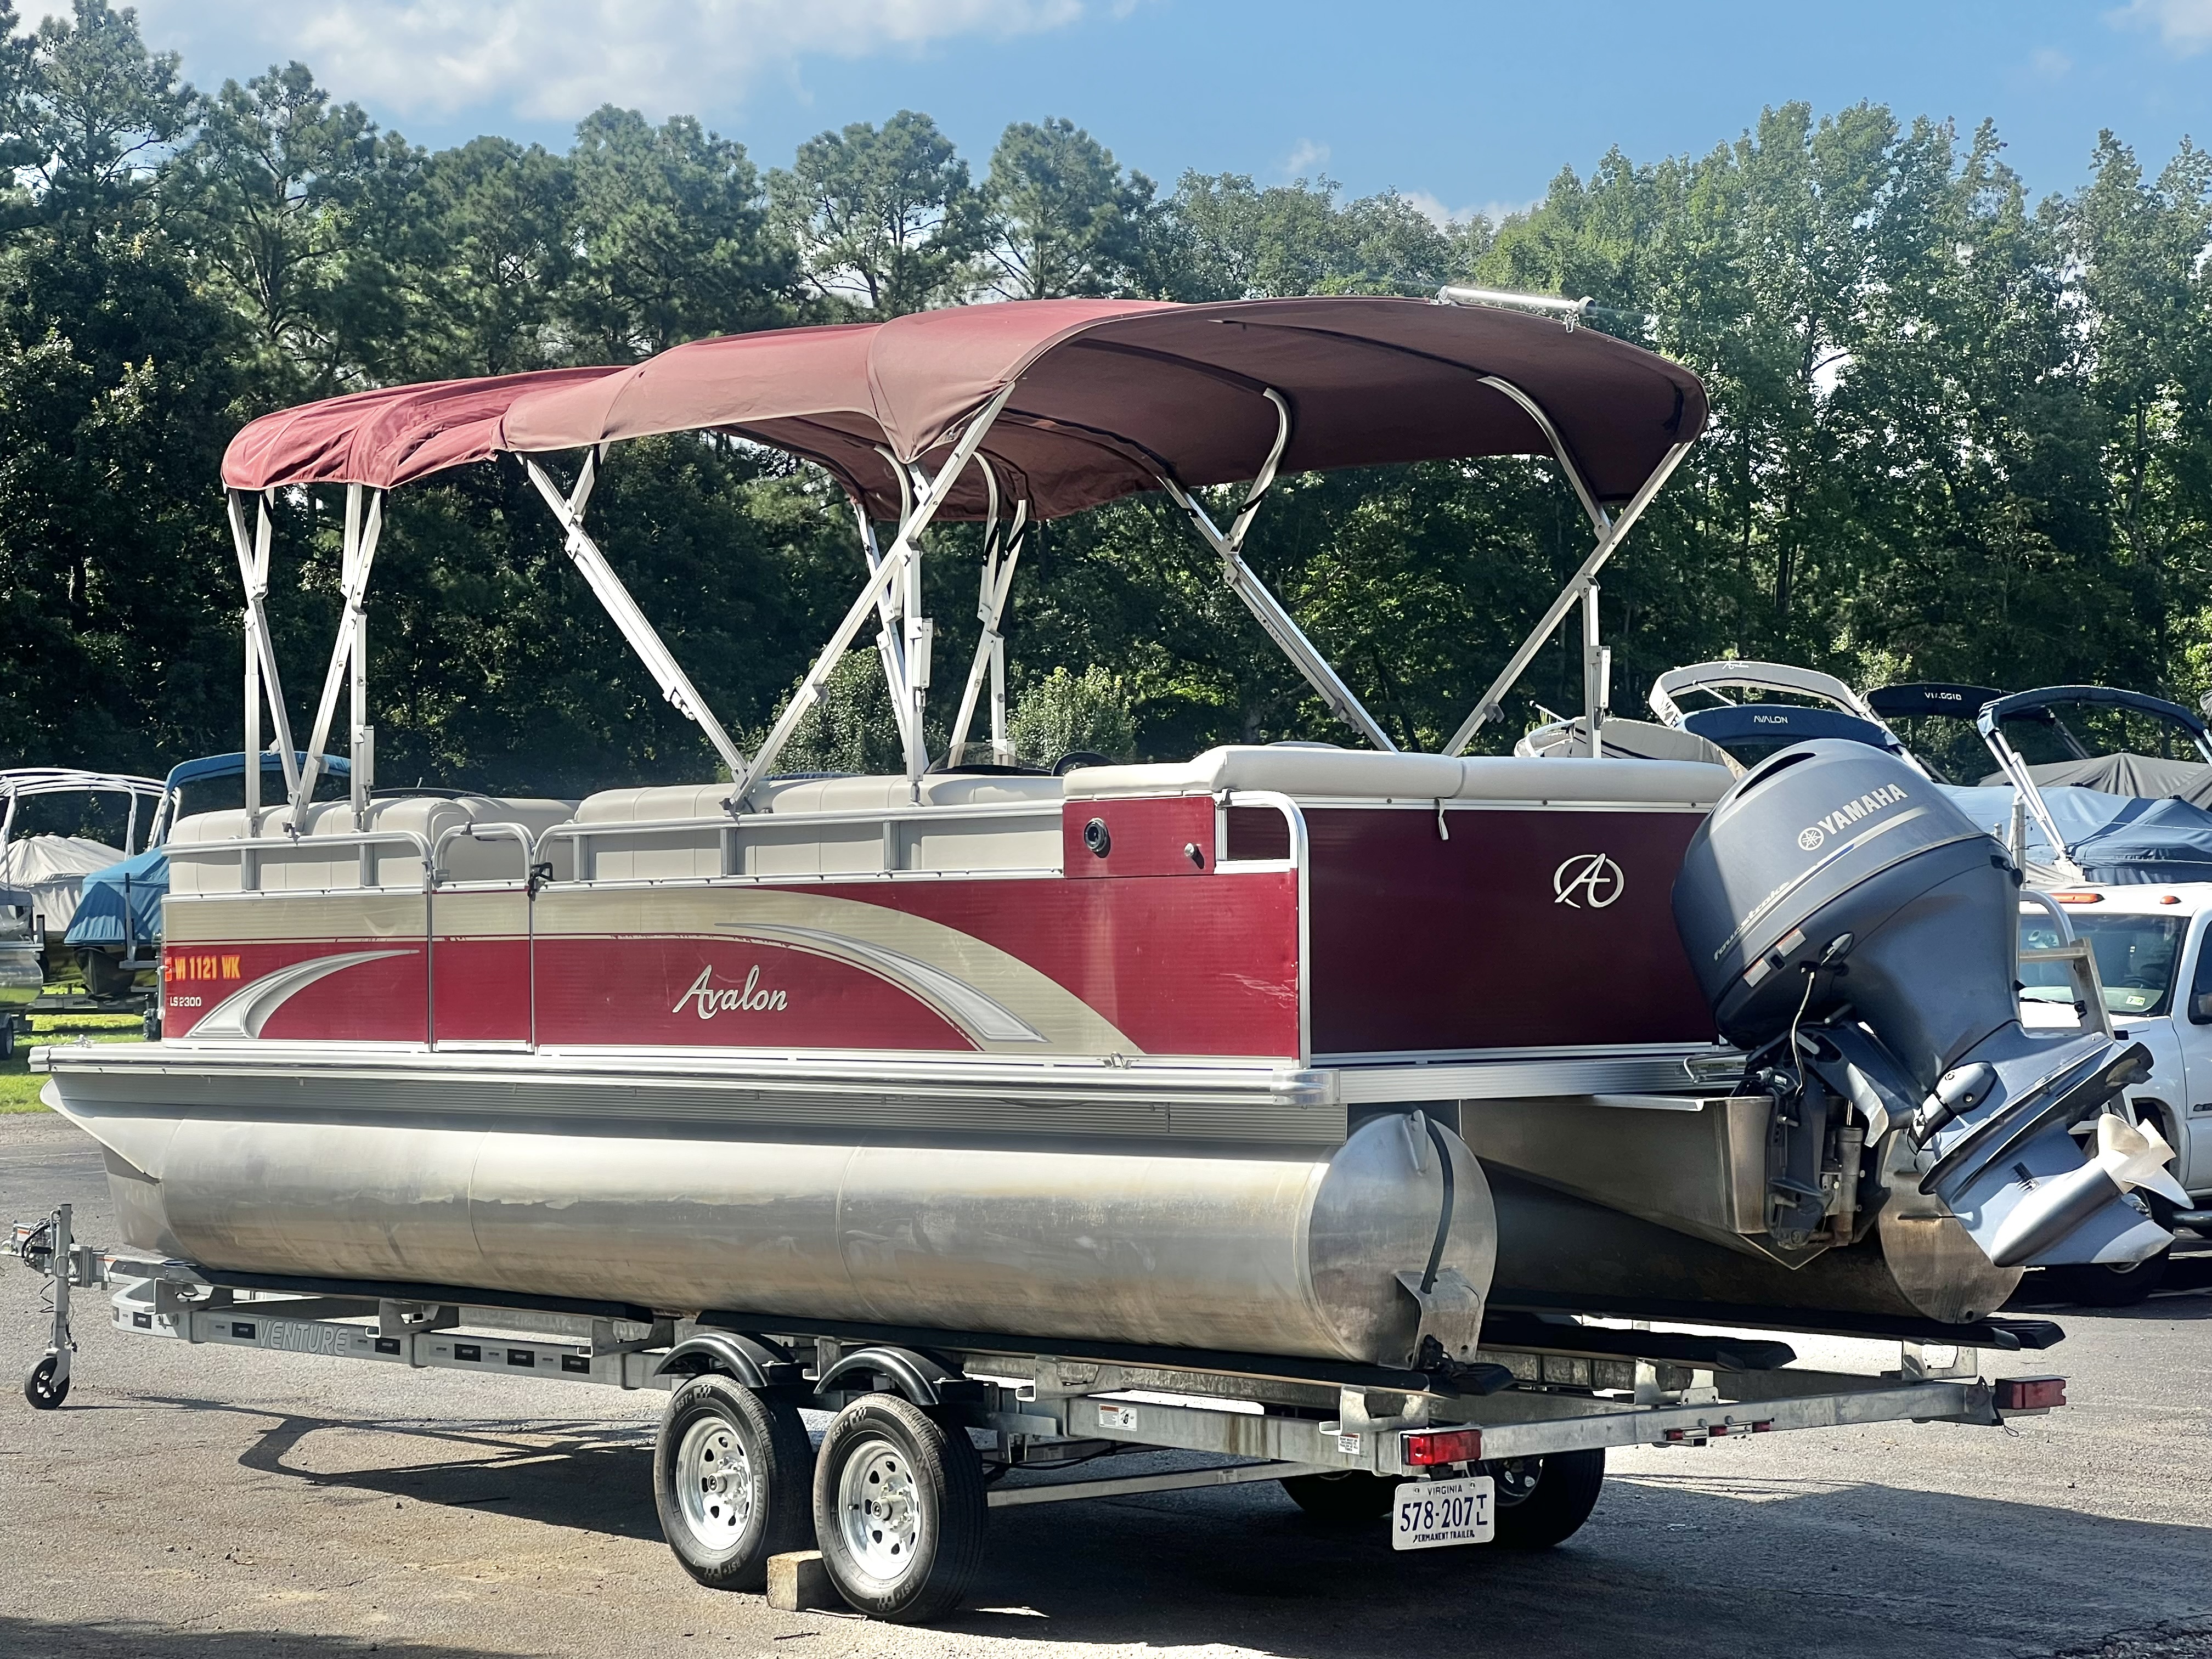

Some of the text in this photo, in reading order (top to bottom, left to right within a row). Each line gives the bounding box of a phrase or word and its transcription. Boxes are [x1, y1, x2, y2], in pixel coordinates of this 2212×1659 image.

[1753, 715, 1788, 724] AVALON
[1817, 783, 1908, 835] YAMAHA
[189, 955, 217, 980] 1121
[222, 955, 240, 980] WK
[672, 964, 788, 1019] Avalon
[258, 1319, 348, 1356] VENTURE
[1427, 1484, 1463, 1496] VIRGINIA
[1400, 1497, 1474, 1532] 578-207
[1450, 1530, 1475, 1539] TRAILER
